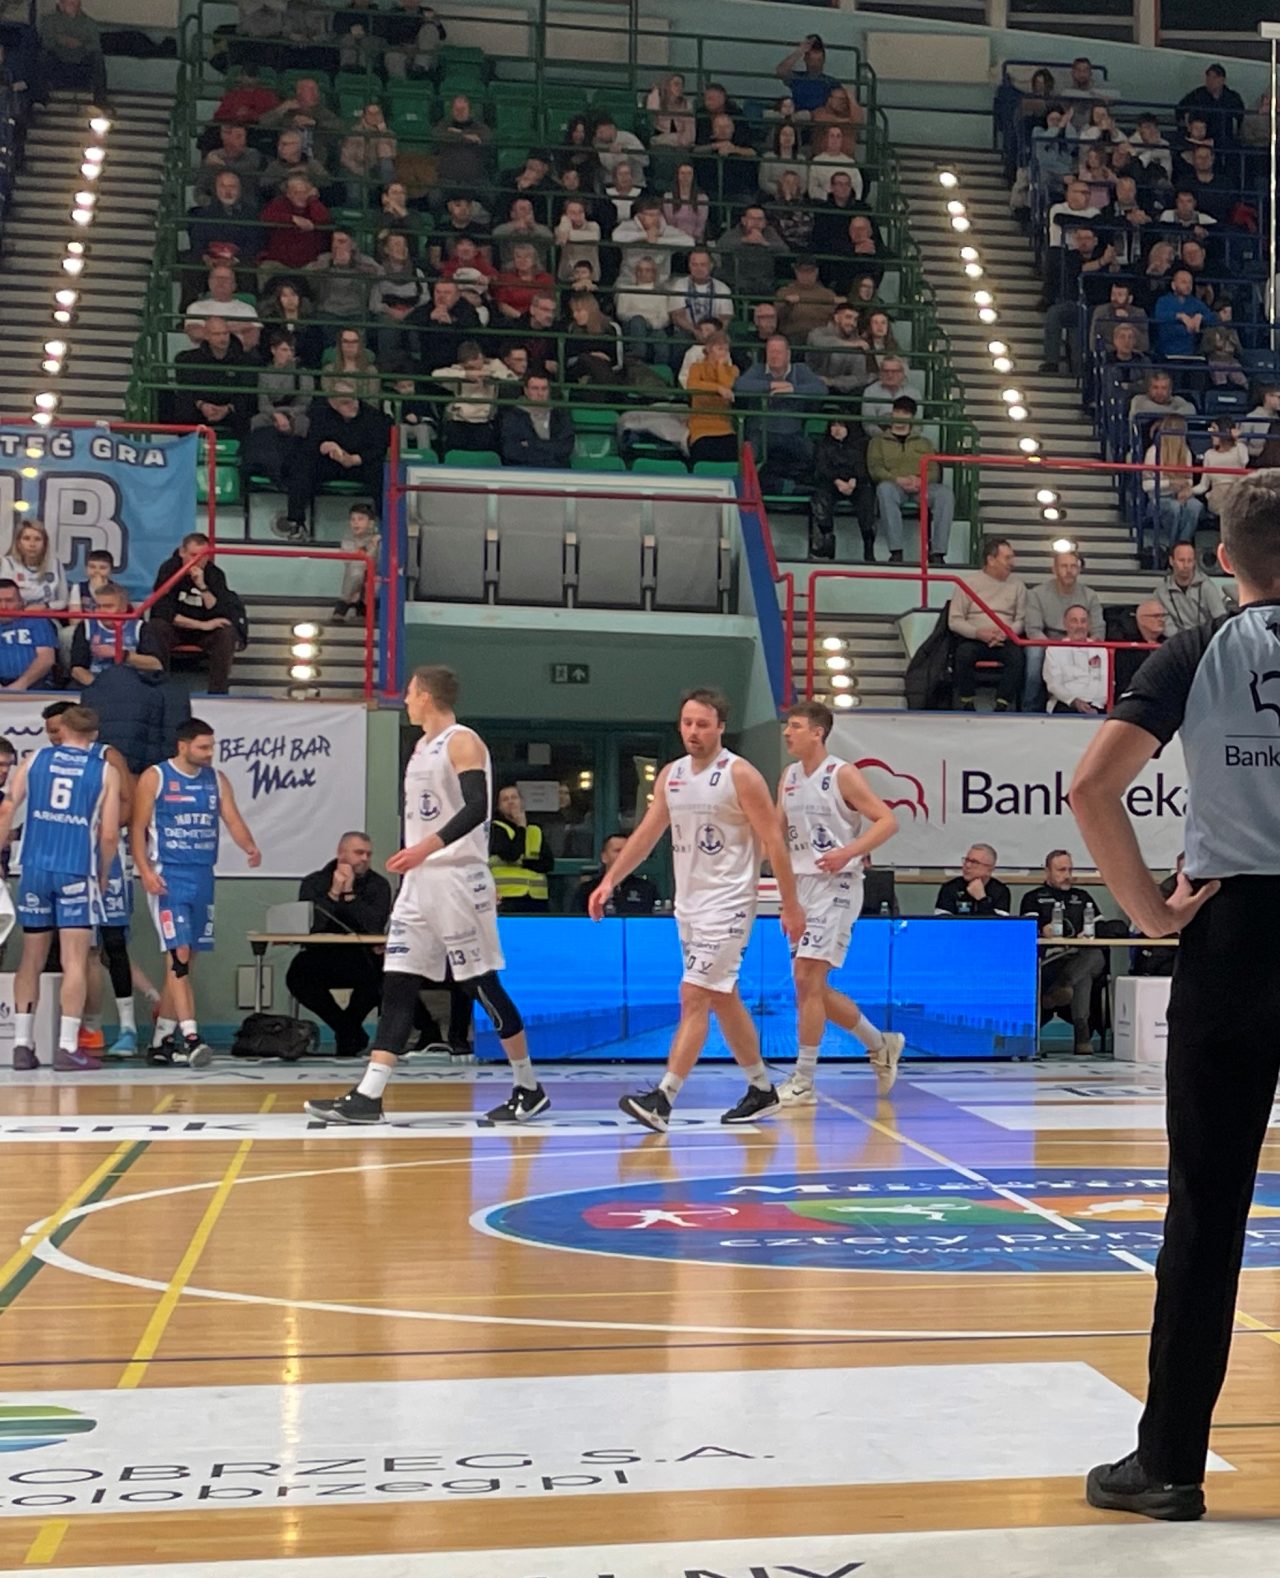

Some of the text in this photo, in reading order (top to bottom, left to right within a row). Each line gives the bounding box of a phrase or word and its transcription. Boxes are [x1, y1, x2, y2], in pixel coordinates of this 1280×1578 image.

[91, 438, 166, 467] GRA
[218, 735, 332, 762] BEACH BAR
[1225, 744, 1280, 767] Bank
[247, 760, 316, 799] Max
[821, 776, 831, 791] 6
[51, 777, 73, 810] 6
[961, 770, 1073, 816] Bank
[448, 949, 467, 966] 13
[0, 1120, 254, 1133] ank
[719, 1235, 967, 1248] cztery
[578, 1446, 776, 1465] S.A.
[0, 1470, 629, 1506] olobrzeg.pl
